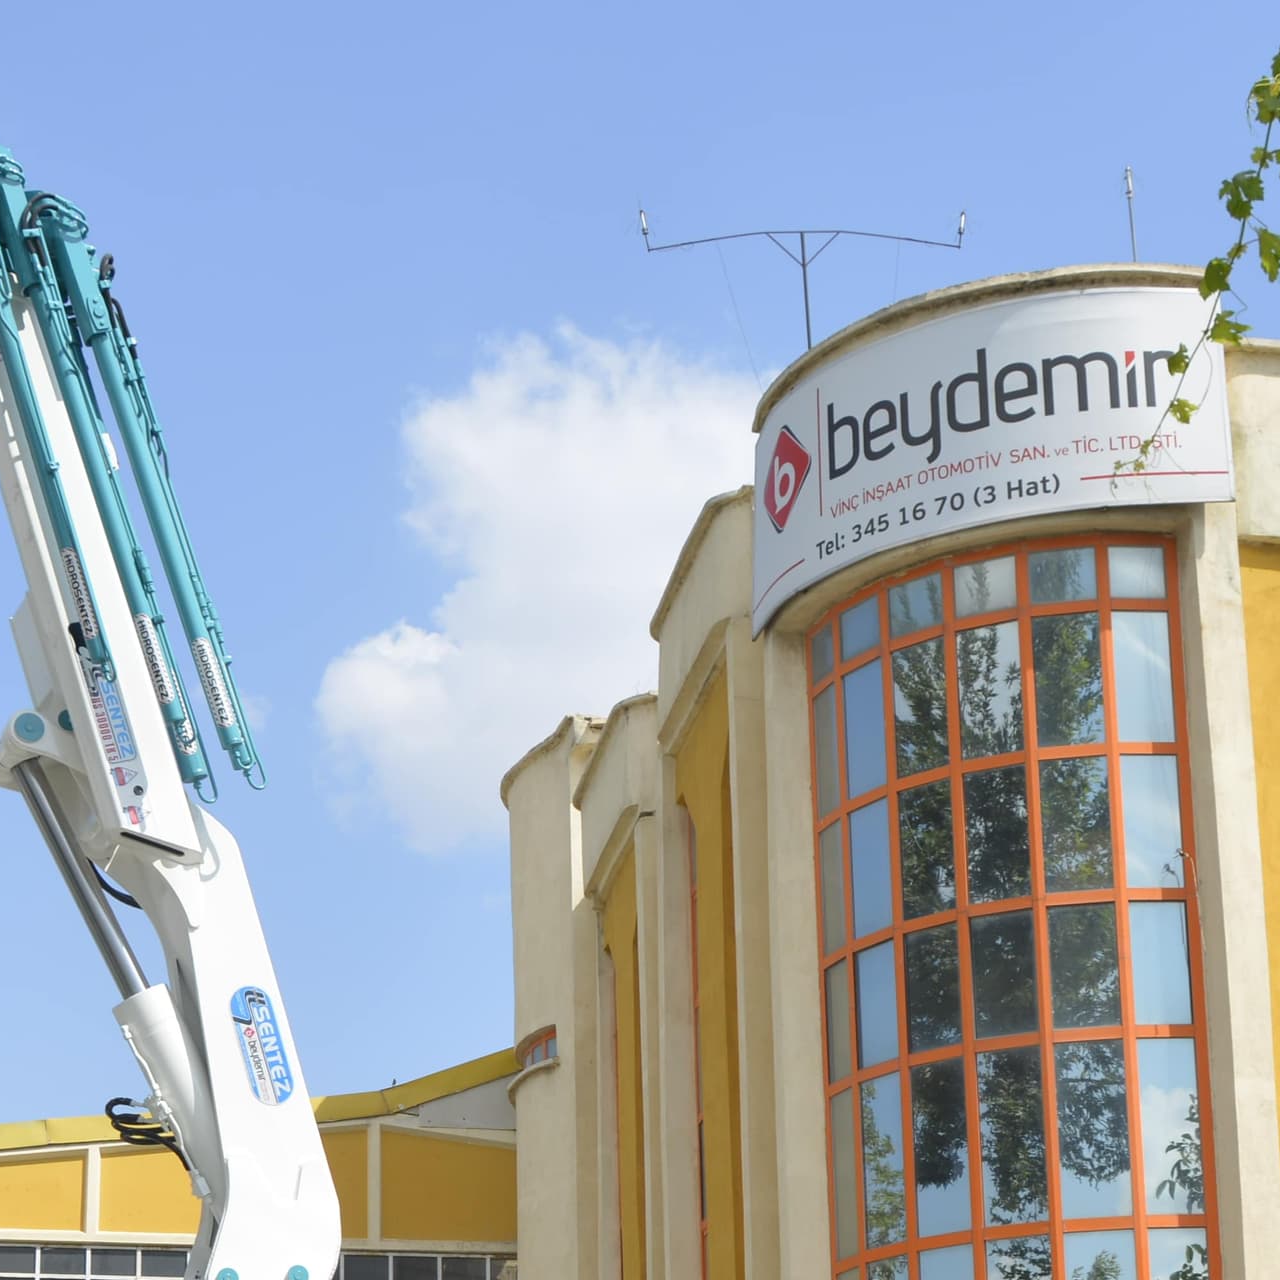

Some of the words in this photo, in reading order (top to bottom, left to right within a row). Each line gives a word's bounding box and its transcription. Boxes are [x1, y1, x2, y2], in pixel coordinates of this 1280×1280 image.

[827, 348, 1174, 481] beydemir
[816, 533, 845, 560] Tel:
[851, 514, 889, 543] 345
[899, 502, 926, 526] 16
[935, 493, 965, 516] 70
[973, 486, 997, 507] (3
[1007, 473, 1061, 500] Hat)
[830, 495, 860, 519] VİNÇ
[862, 474, 913, 505] İNŞAAT
[917, 451, 1002, 485] OTOMOTİV
[1009, 445, 1051, 464] SAN.
[1055, 448, 1069, 457] ve
[1072, 436, 1104, 454] TİC.
[101, 681, 133, 758] SENTEZ
[253, 1006, 291, 1097] SENTEZ
